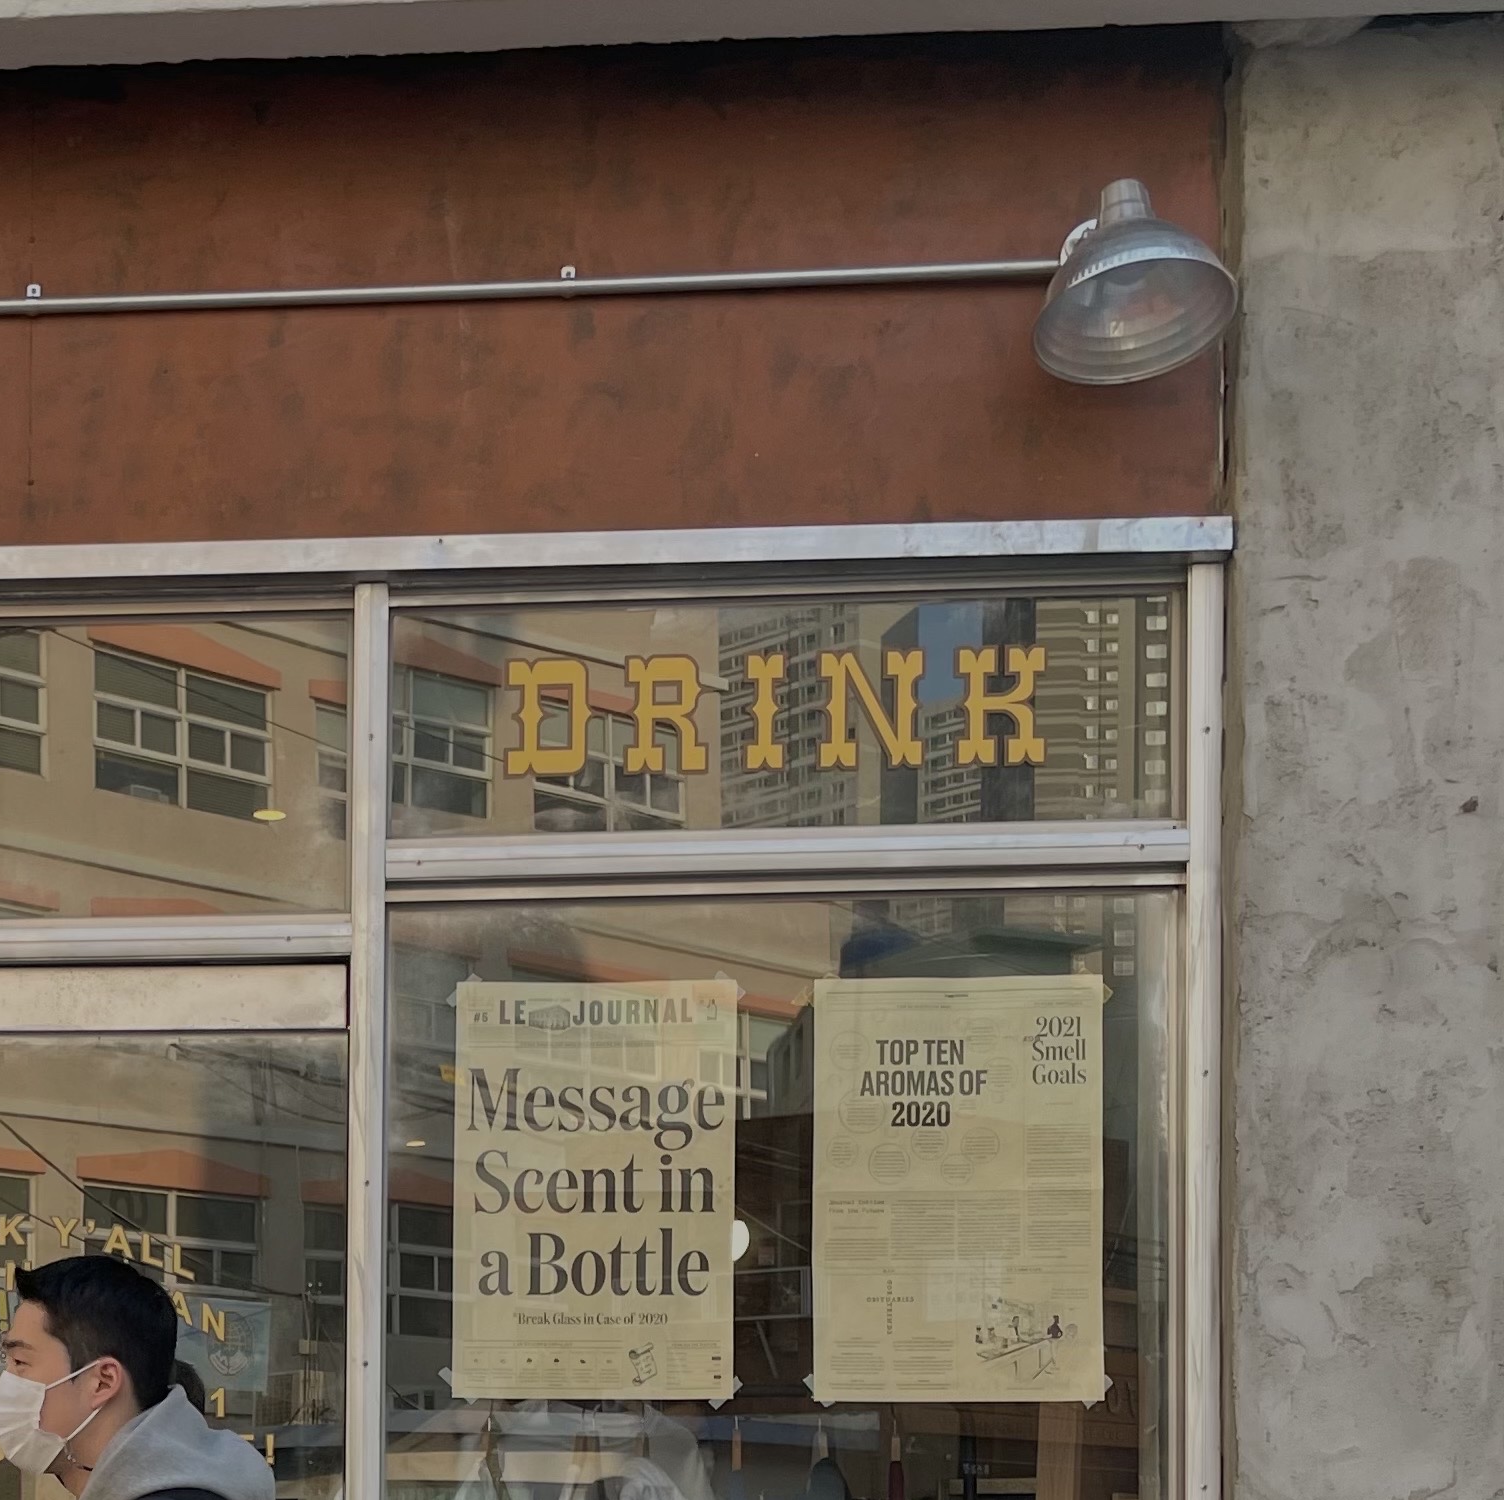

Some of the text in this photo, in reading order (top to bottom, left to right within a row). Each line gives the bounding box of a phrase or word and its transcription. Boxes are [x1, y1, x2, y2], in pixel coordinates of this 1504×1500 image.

[502, 645, 1048, 777] DRINK
[499, 999, 527, 1025] LE
[572, 998, 693, 1026] JOURNAL
[1036, 1016, 1081, 1037] 2021
[876, 1039, 964, 1065] TOP TEN
[1031, 1038, 1086, 1061] Smell
[860, 1069, 988, 1096] AROMAS OF
[1032, 1063, 1087, 1086] Goals
[465, 1067, 725, 1151] Message
[891, 1101, 950, 1127] 2020
[474, 1150, 716, 1214] Scent in
[52, 1216, 196, 1281] Y'ALL
[478, 1227, 710, 1298] a Bottle
[172, 1291, 225, 1342] AN
[552, 1311, 582, 1325] Glass
[583, 1311, 594, 1325] in
[596, 1311, 622, 1325] Case
[623, 1311, 637, 1325] of
[638, 1312, 668, 1325] 2020
[210, 1387, 225, 1418] 1
